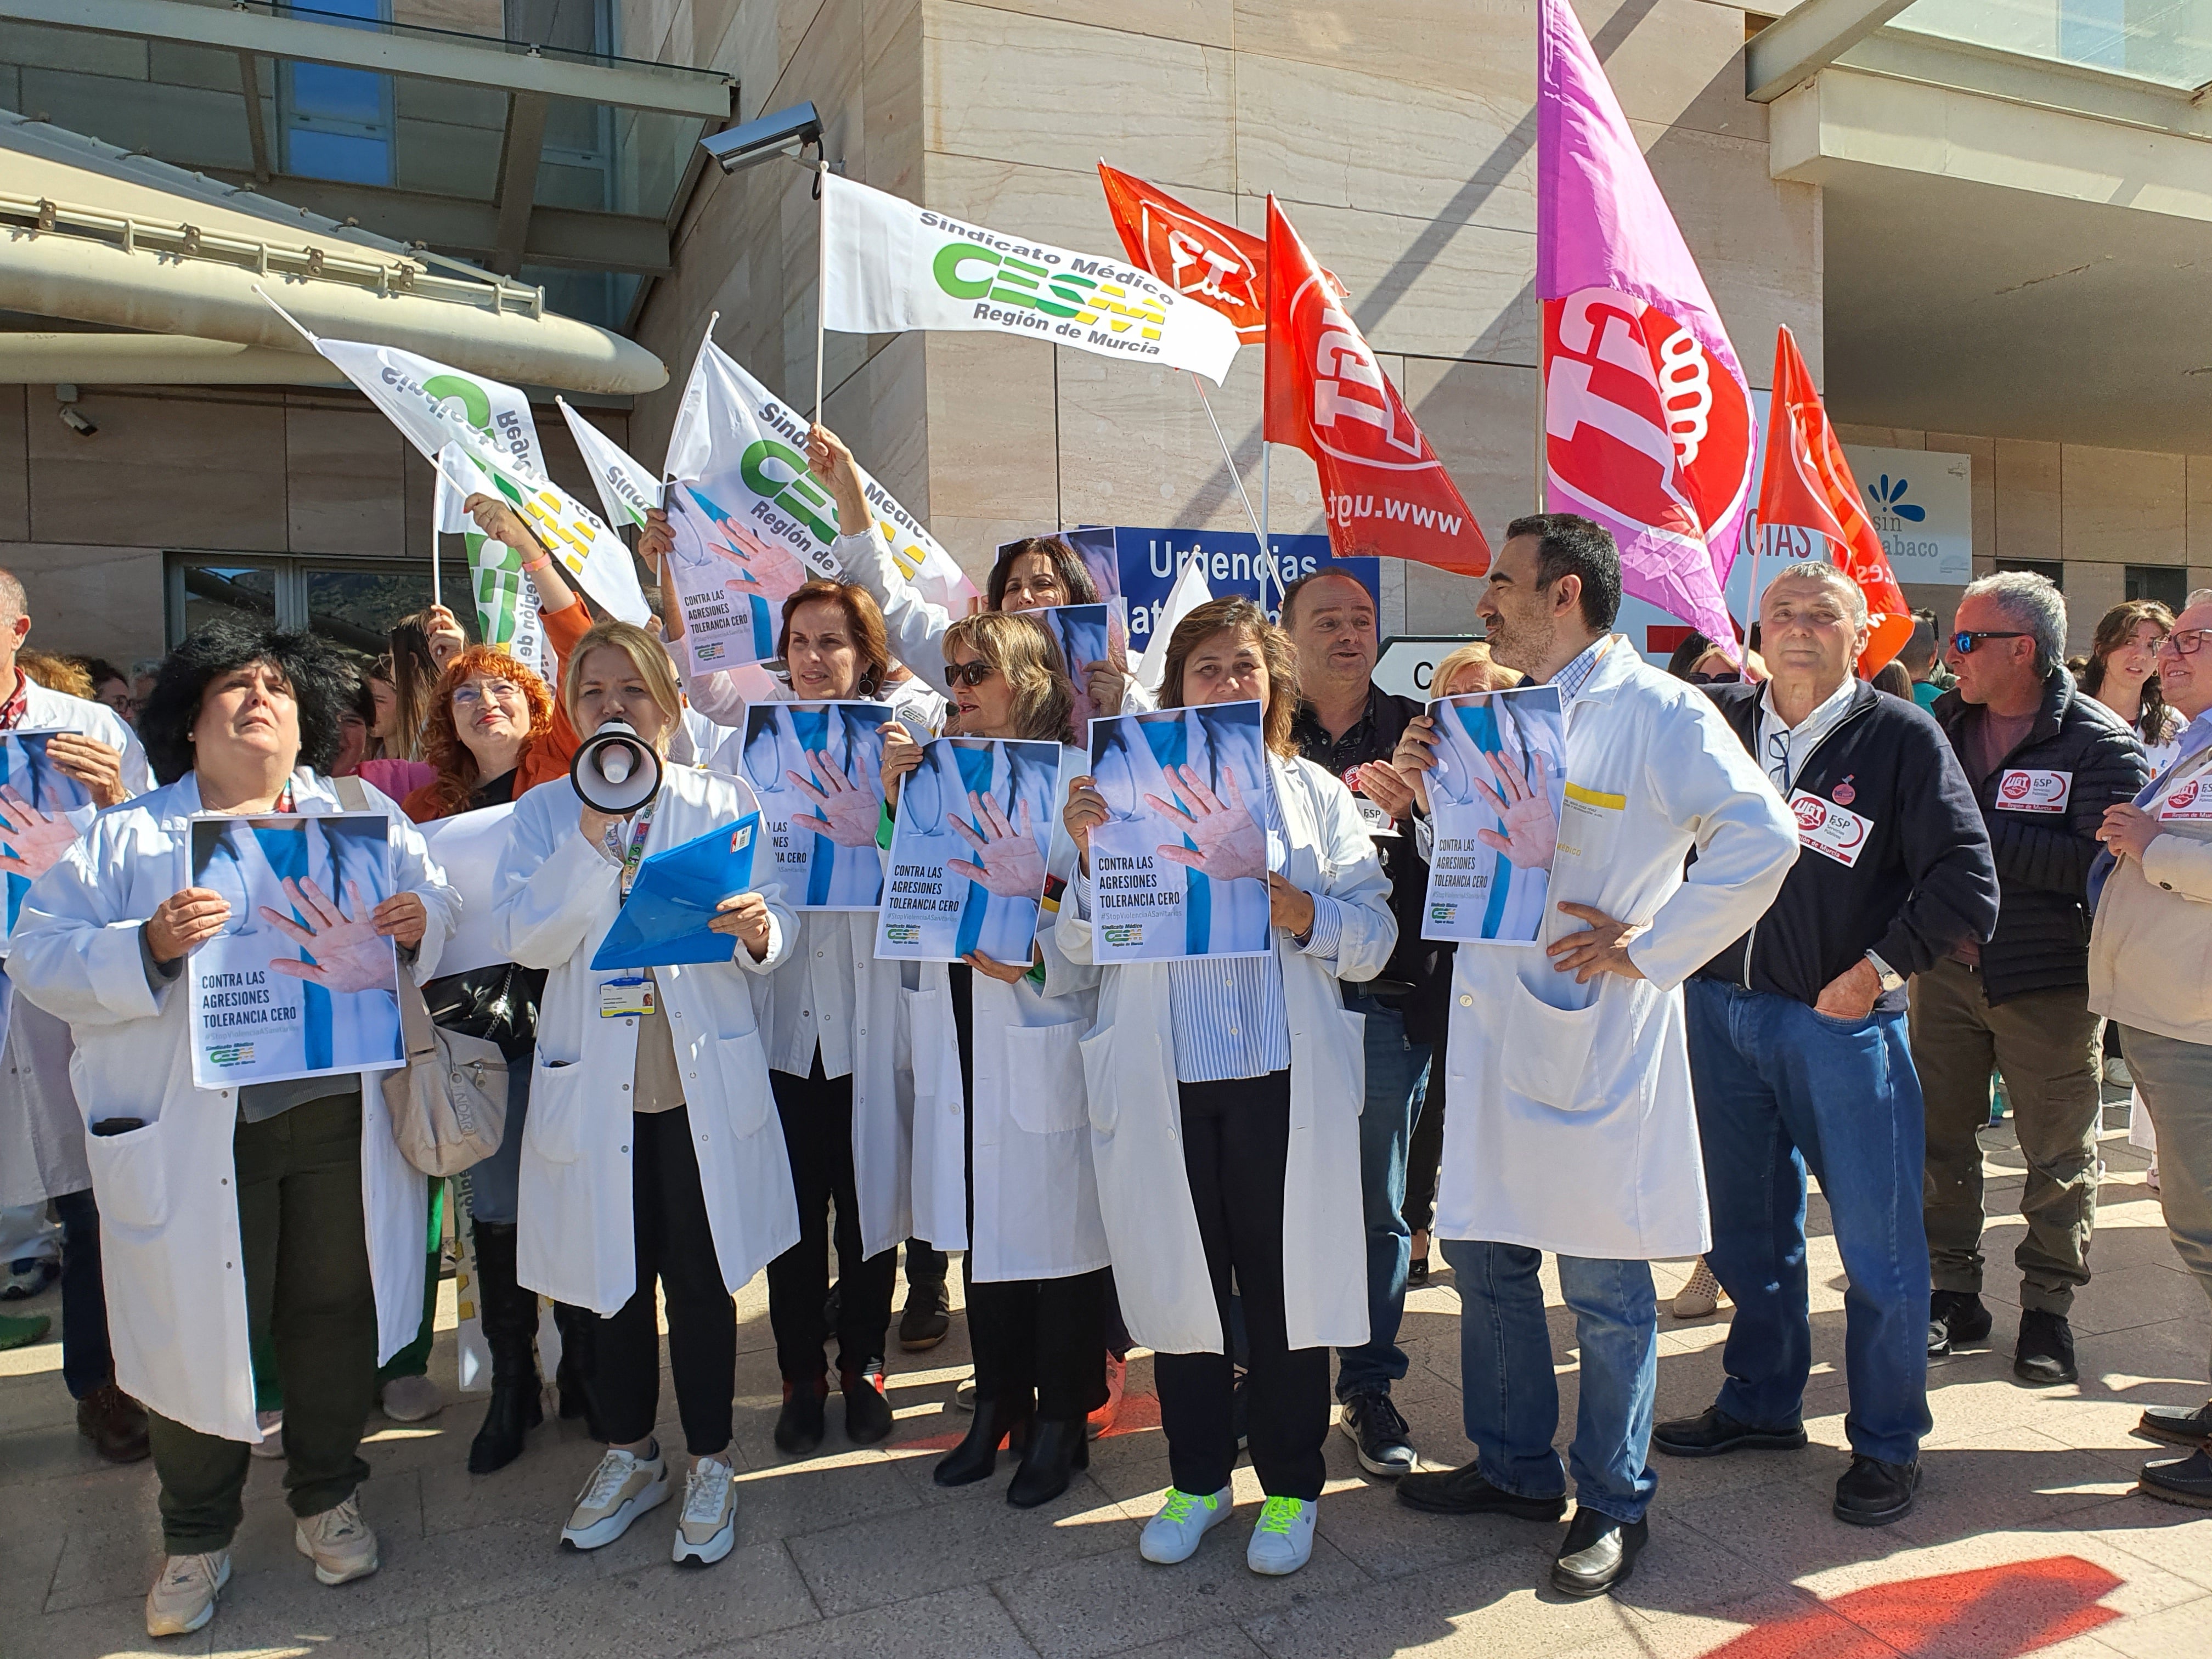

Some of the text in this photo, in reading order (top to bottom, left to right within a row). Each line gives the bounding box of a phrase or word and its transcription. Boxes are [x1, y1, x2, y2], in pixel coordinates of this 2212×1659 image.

[919, 212, 1174, 306] Sindicato Médico
[933, 242, 1166, 341] CESM
[973, 303, 1160, 356] Región de Murcia
[1872, 515, 1903, 532] sin
[751, 500, 834, 571] Región de
[1882, 534, 1938, 557] abaco
[684, 590, 725, 606] CONTRA LAS
[688, 603, 730, 620] AGRESIONES
[690, 614, 748, 634] TOLERANCIA CERO
[1413, 661, 1433, 690] C
[2006, 776, 2029, 788] UGT
[1794, 799, 1824, 821] UGT
[773, 821, 788, 832] LAS
[1439, 838, 1475, 851] CONTRA LAS
[1812, 839, 1820, 848] de
[1820, 844, 1841, 858] Murcia
[787, 852, 806, 863] CERO
[1098, 856, 1153, 871] CONTRA LAS
[1436, 856, 1476, 870] AGRESIONES
[894, 865, 943, 878] CONTRA LAS
[891, 881, 943, 895] AGRESIONES
[1099, 874, 1157, 890] AGRESIONES
[1435, 874, 1488, 888] TOLERANCIA CERO
[889, 897, 960, 912] TOLERANCIA CERO
[1099, 891, 1180, 908] TOLERANCIA CERO
[1101, 910, 1182, 921] #StopViolenciaASanitarios
[202, 970, 265, 989] CONTRA LAS
[202, 989, 270, 1009] AGRESIONES
[202, 1006, 297, 1029] TOLERANCIA CERO
